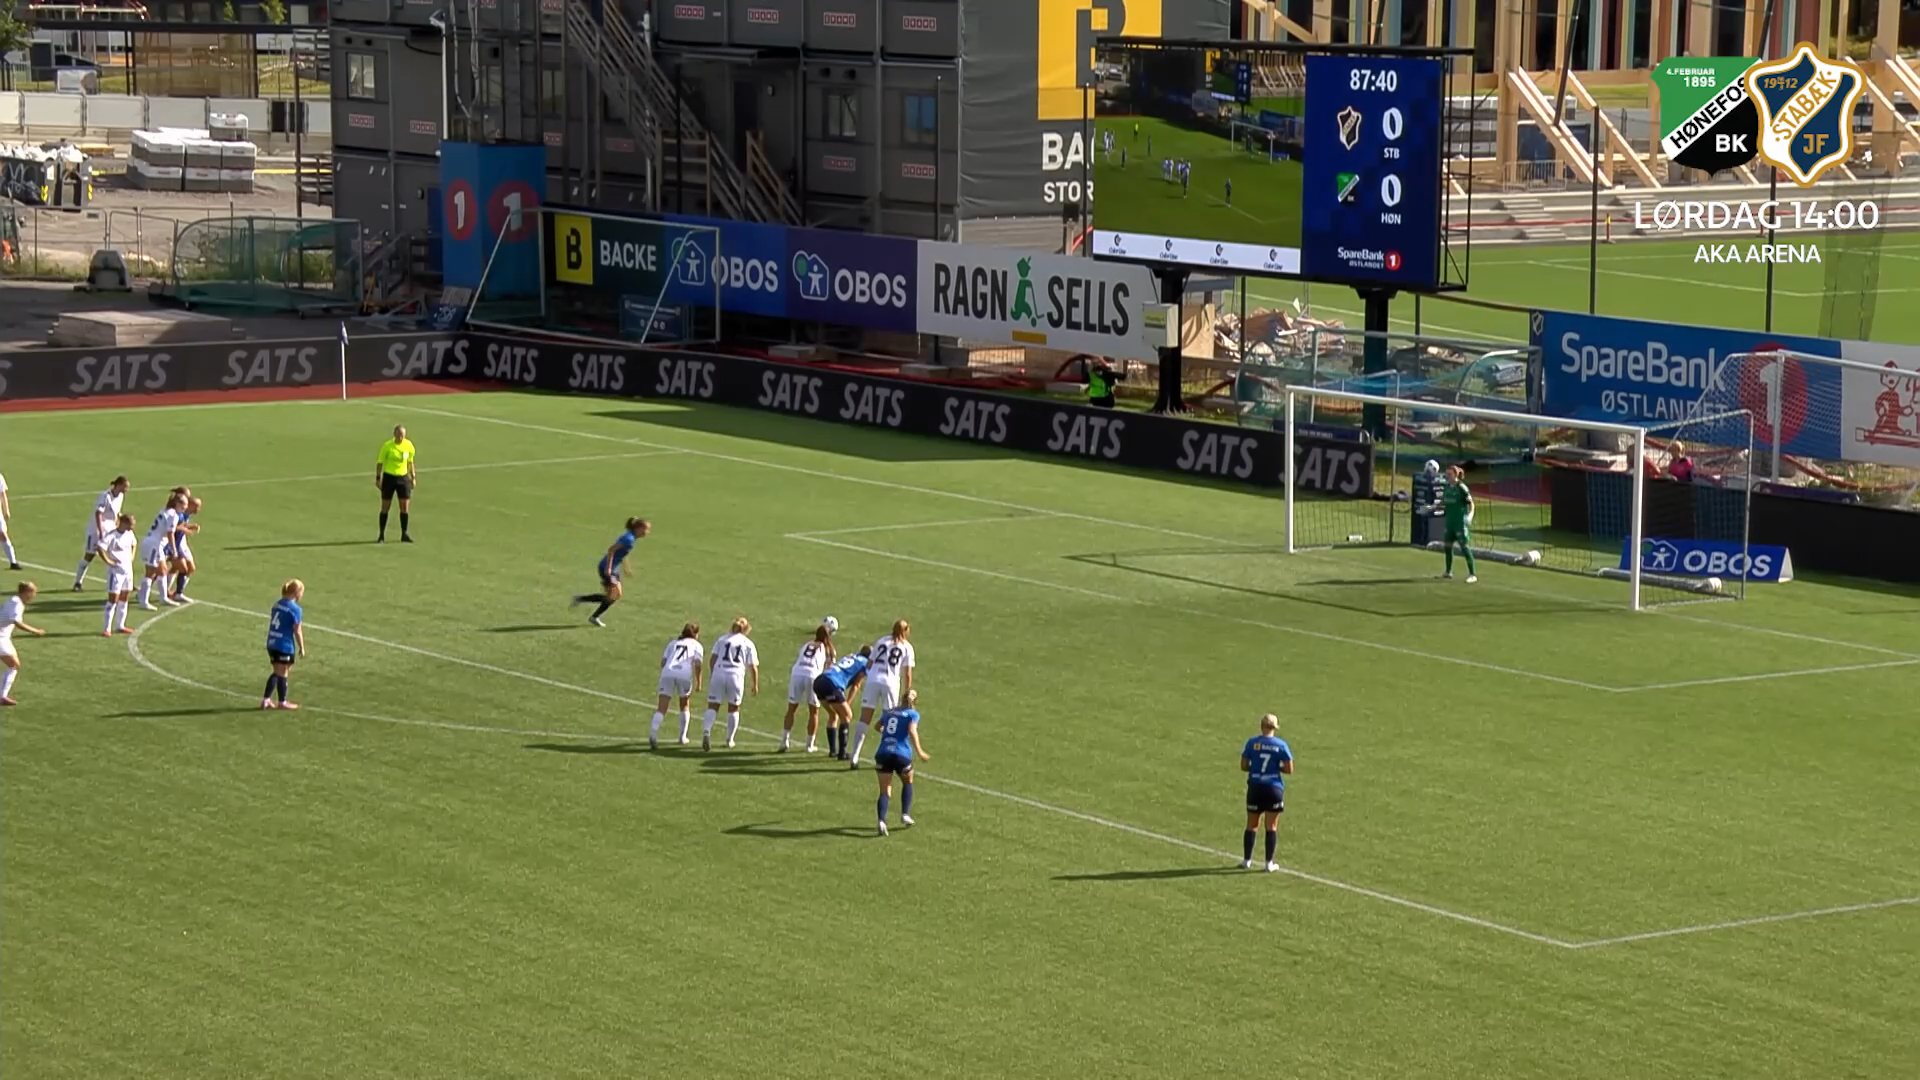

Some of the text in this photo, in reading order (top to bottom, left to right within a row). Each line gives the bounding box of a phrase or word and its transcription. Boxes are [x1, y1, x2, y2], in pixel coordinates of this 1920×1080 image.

[1350, 69, 1397, 92] 87:40
[1382, 107, 1404, 140] 0
[1042, 128, 1095, 171] BA
[1383, 147, 1400, 159] STB
[1381, 173, 1402, 207] 0
[454, 191, 465, 230] 1
[503, 192, 522, 231] 1
[1381, 212, 1402, 225] HØN
[566, 227, 582, 270] B
[600, 239, 657, 272] BACKE
[1338, 246, 1384, 261] SpareBank
[711, 255, 778, 293] OBOS
[834, 268, 907, 308] OBOS
[934, 262, 1130, 336] RAGN SELLS
[69, 353, 173, 393] SATS
[222, 347, 317, 385] SATS
[381, 339, 470, 378] SATS
[484, 343, 539, 383] SATS
[568, 352, 626, 391] SATS
[1560, 331, 1726, 392] SpareBank
[655, 358, 716, 398] SATS
[758, 370, 823, 414] SATS
[839, 382, 905, 427] SATS
[939, 397, 1010, 443] SATS
[1601, 390, 1729, 428] ØSTLANDET
[1046, 411, 1125, 459] SATS
[1176, 429, 1258, 480] SATS
[1683, 550, 1772, 577] OBOS
[271, 611, 281, 630] 4
[675, 645, 688, 660] 7
[722, 642, 741, 664] 11
[876, 643, 903, 667] 28
[887, 717, 898, 734] 8
[1259, 753, 1271, 773] 7
